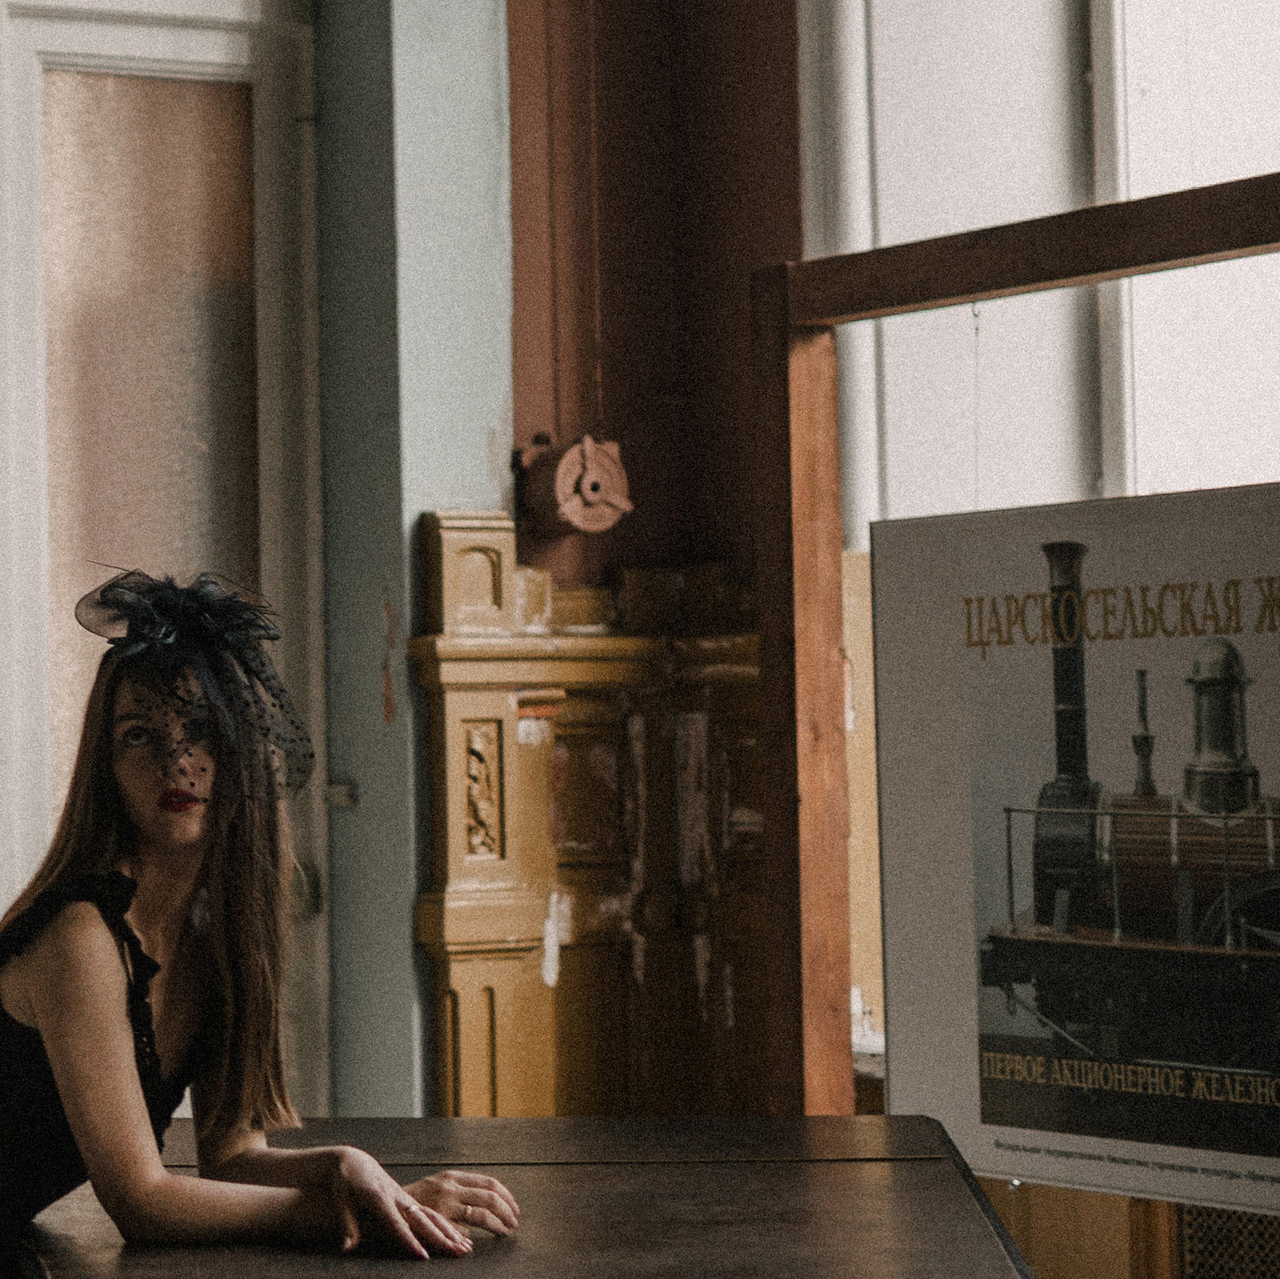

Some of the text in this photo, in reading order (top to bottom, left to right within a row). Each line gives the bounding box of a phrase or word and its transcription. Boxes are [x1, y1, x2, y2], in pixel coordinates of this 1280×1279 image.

[963, 577, 1244, 660] ЦАРСКОСЕЛЬСКАЯ
[982, 1052, 1047, 1084] ПЕРВОЕ
[1050, 1058, 1186, 1099] АКЦИОНЕРНОЕ
